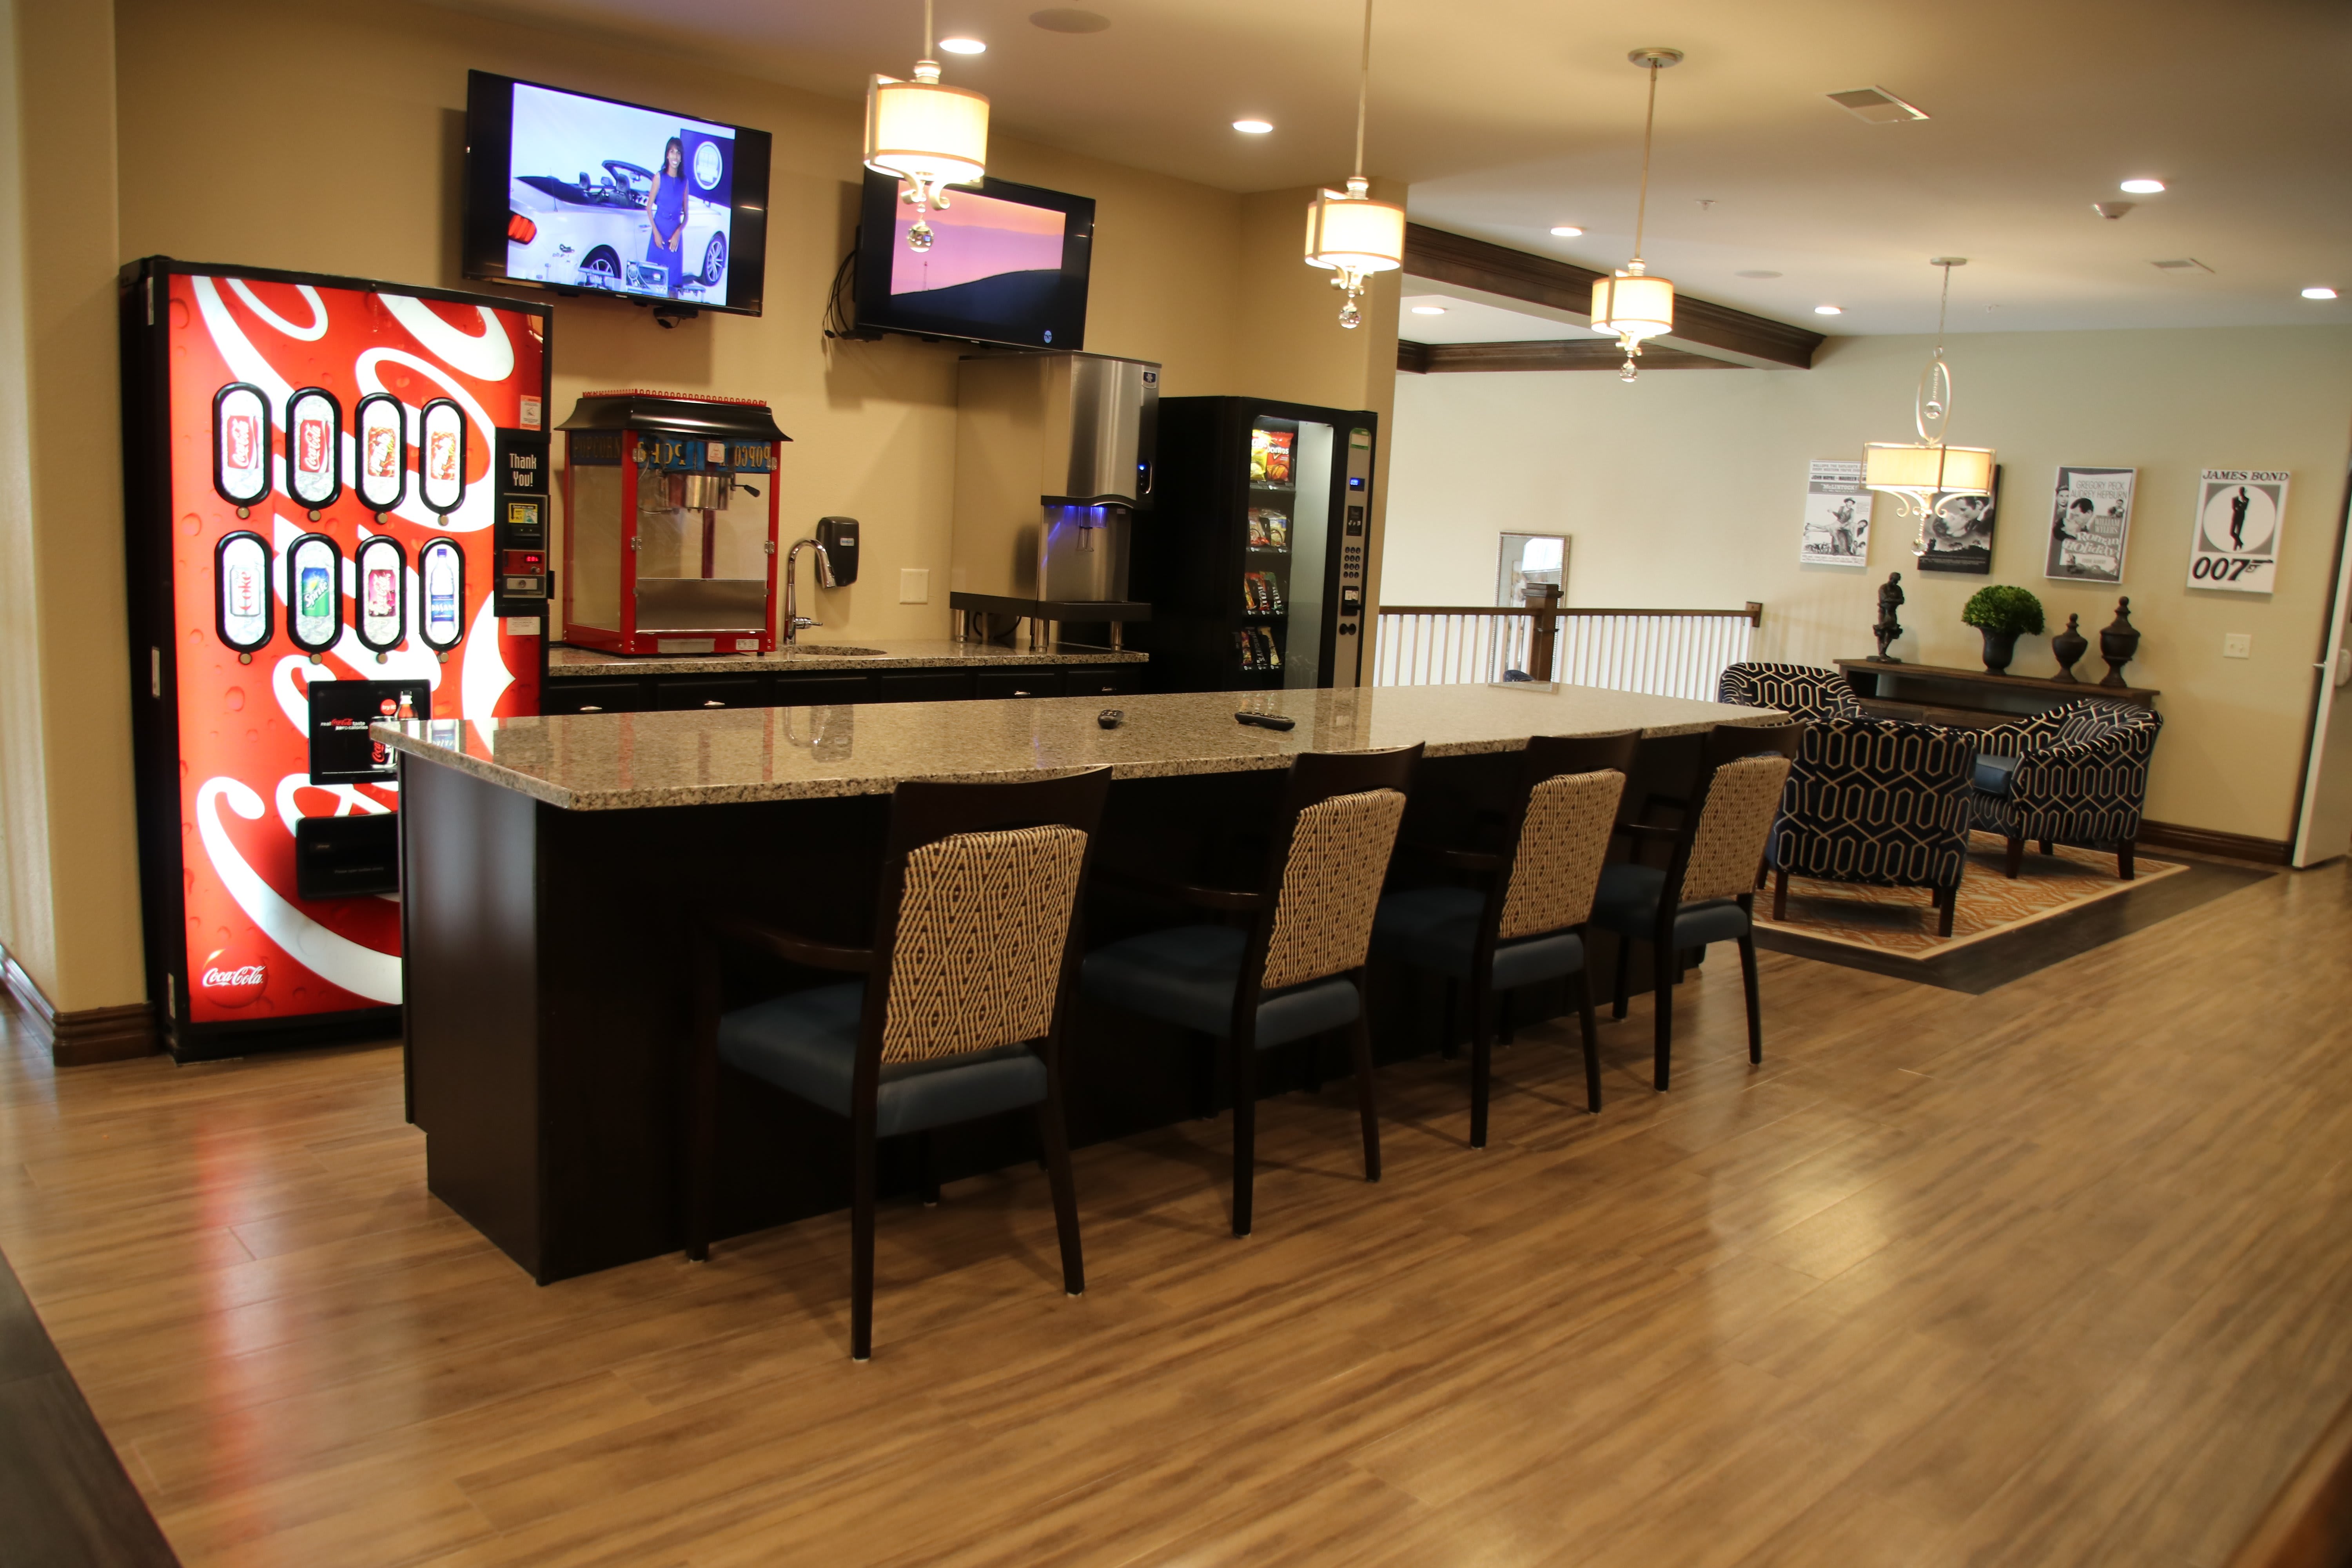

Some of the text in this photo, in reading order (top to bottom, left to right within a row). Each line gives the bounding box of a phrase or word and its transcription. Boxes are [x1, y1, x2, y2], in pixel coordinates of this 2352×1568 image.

[509, 453, 537, 470] Thank
[513, 471, 533, 487] You!
[2203, 470, 2289, 481] JAMES BOND
[2076, 481, 2125, 490] GREGORY PECK
[2071, 489, 2127, 499] AUDREY HEPBURN
[2192, 556, 2250, 581] 007
[238, 571, 252, 611] Coke
[303, 581, 328, 608] Sprite
[432, 603, 454, 612] DASANI
[202, 965, 267, 988] Coca-Cola
